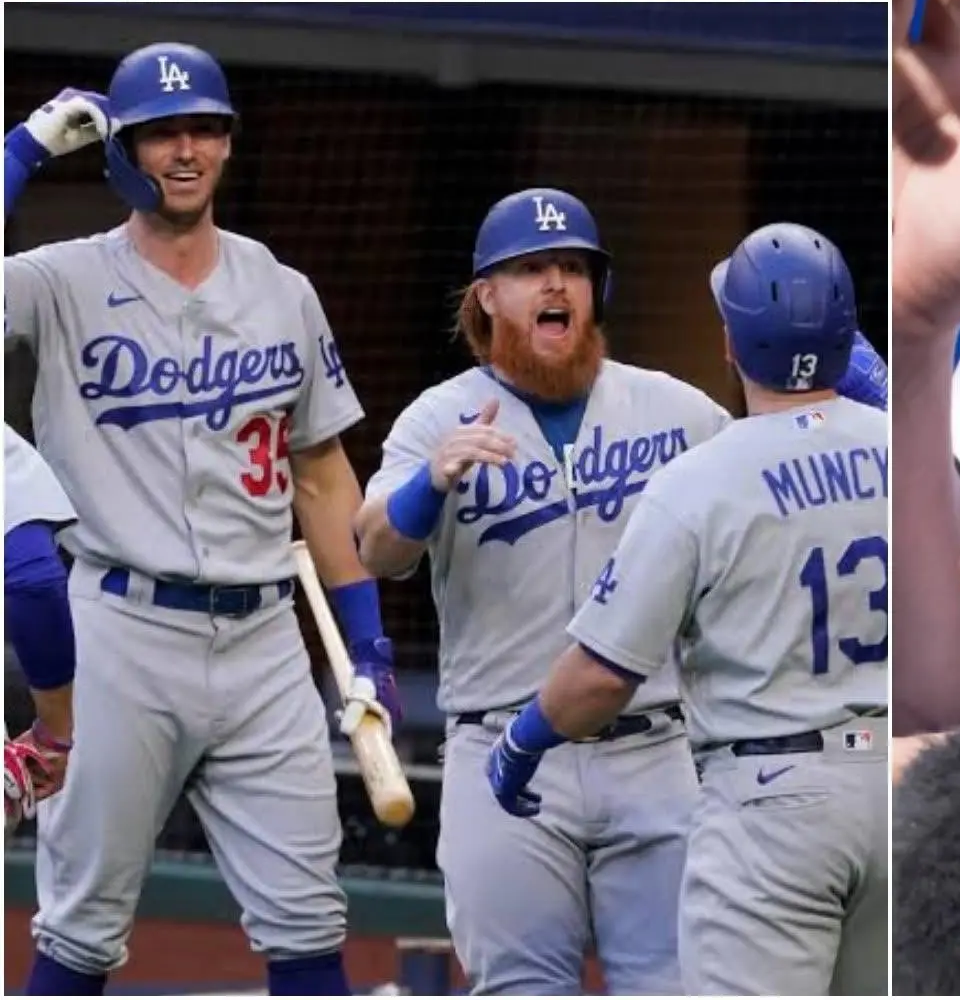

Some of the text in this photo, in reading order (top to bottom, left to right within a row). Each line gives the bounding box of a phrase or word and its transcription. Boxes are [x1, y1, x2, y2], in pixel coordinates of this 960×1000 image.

[157, 55, 191, 92] LA
[532, 195, 568, 232] LA
[79, 335, 304, 431] Dodgers
[791, 353, 818, 378] 13
[761, 446, 888, 517] MUNCY
[799, 535, 888, 675] 13
